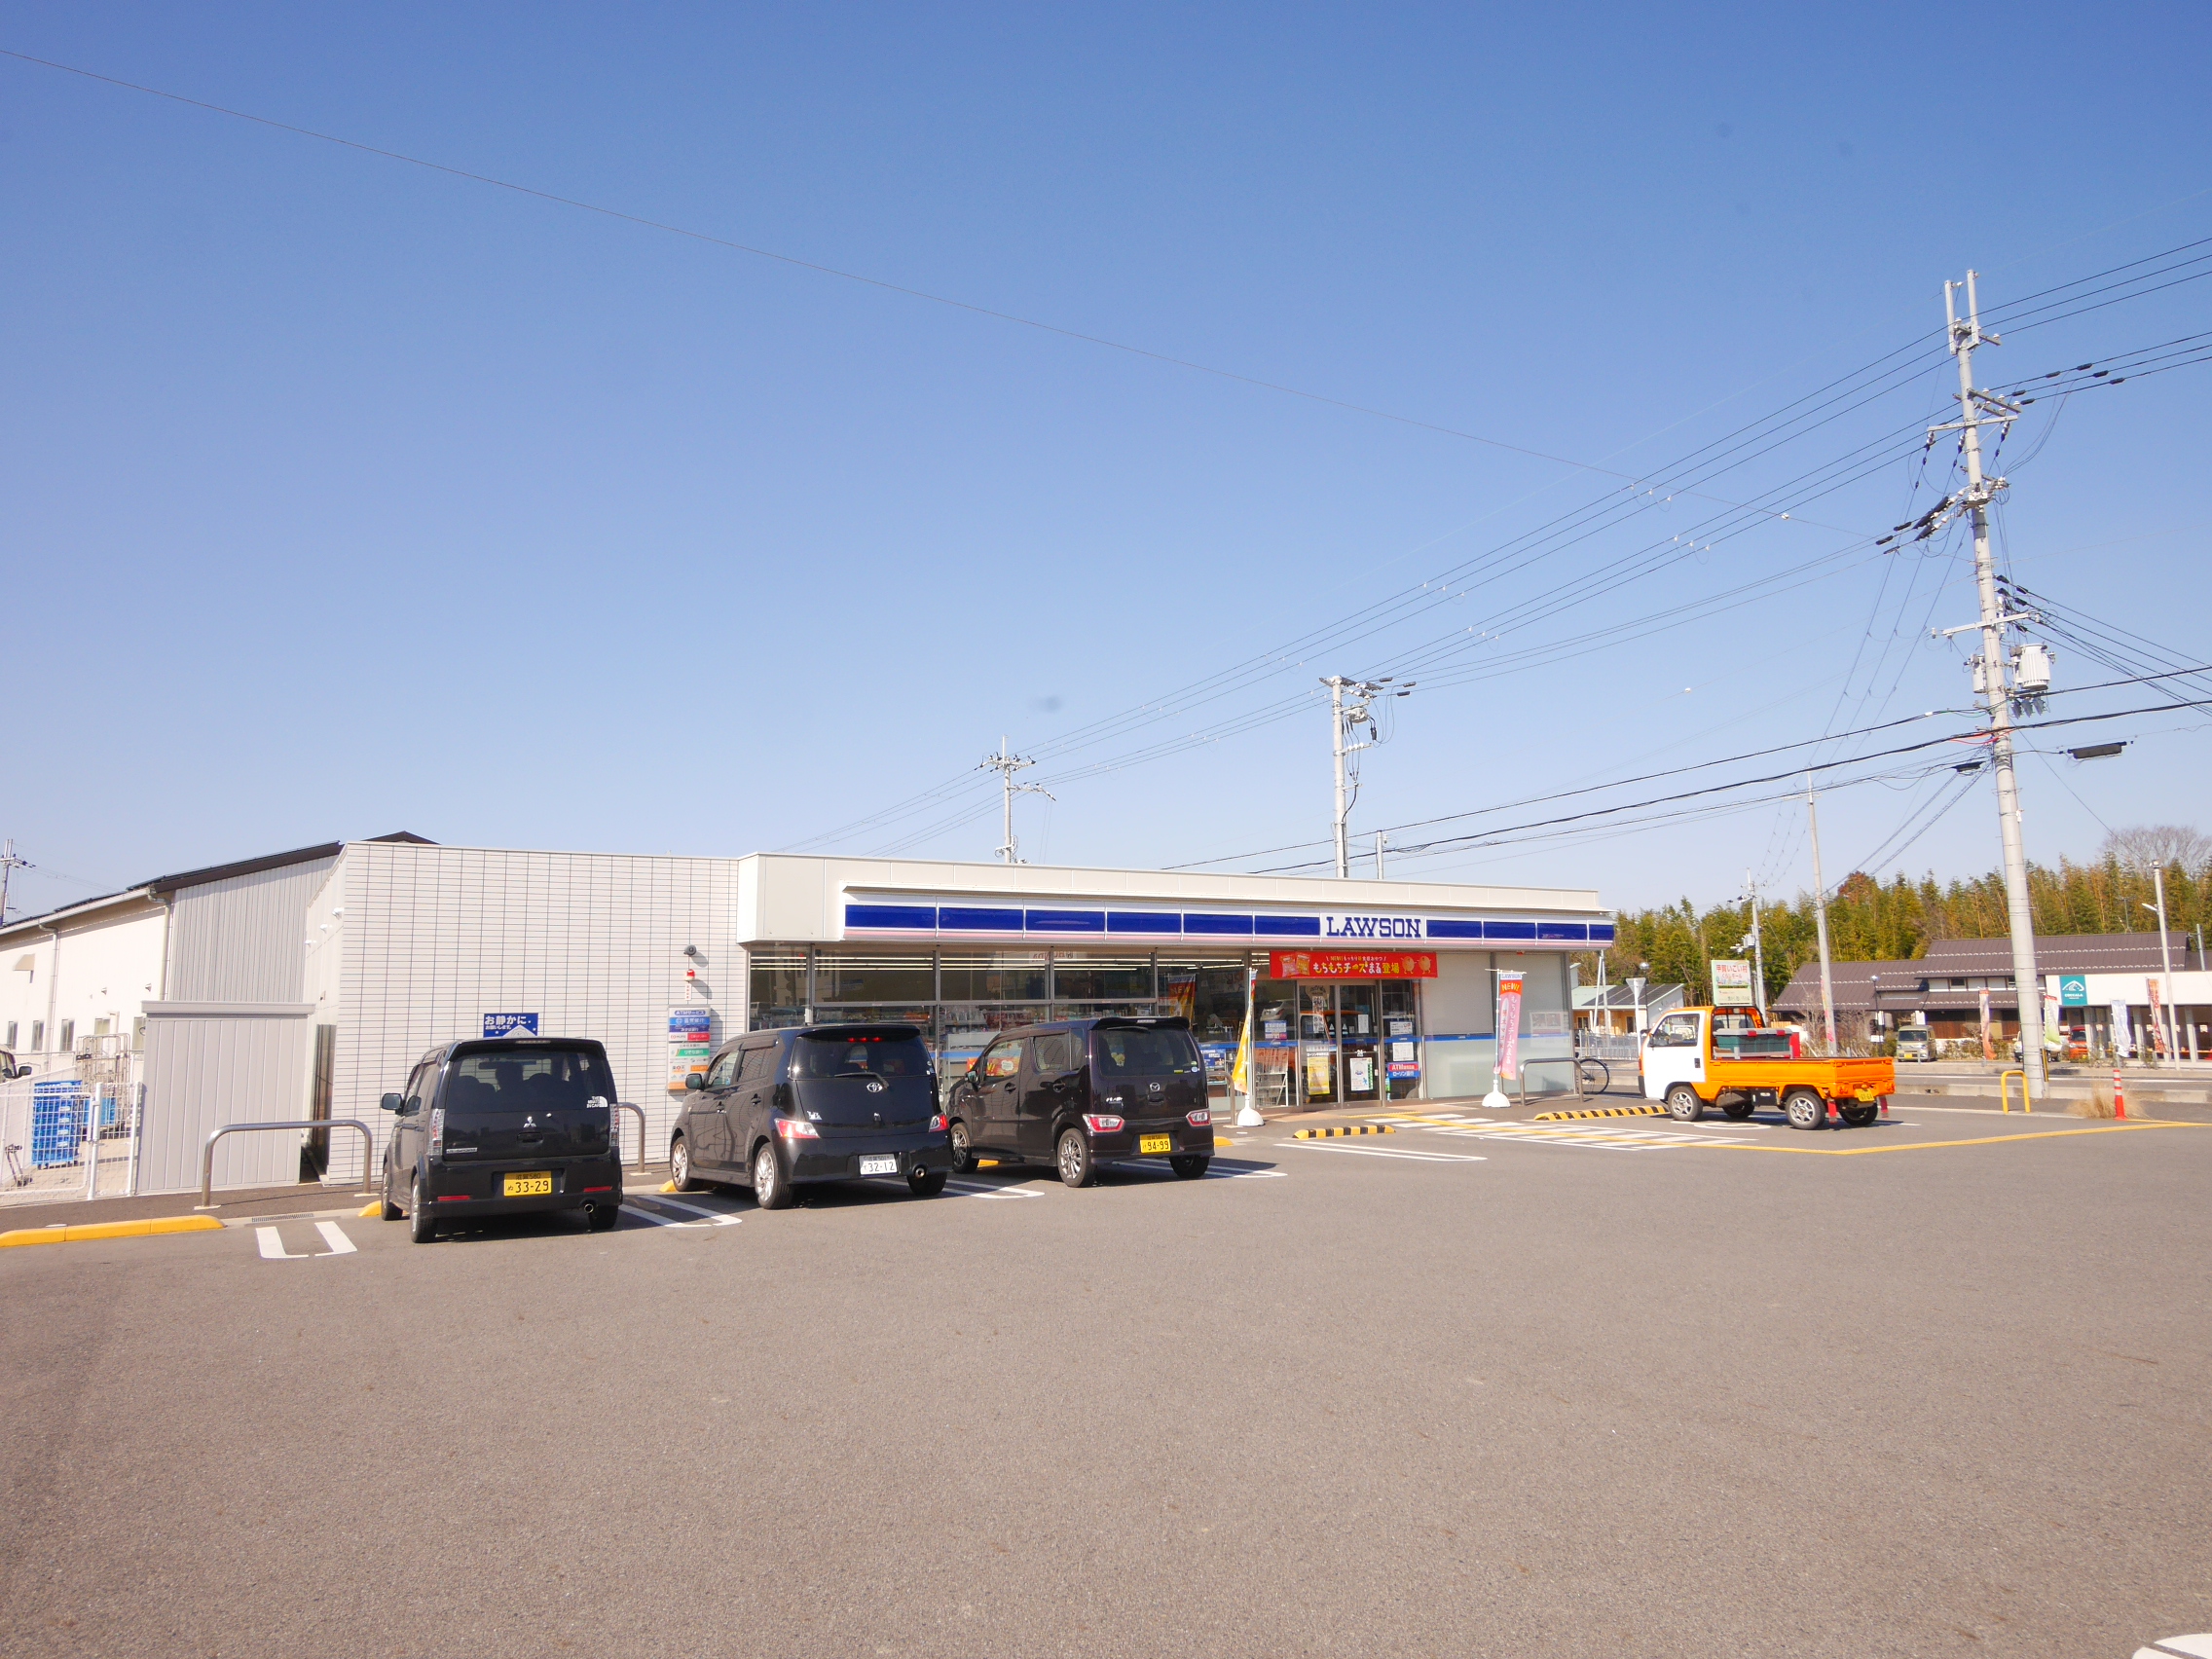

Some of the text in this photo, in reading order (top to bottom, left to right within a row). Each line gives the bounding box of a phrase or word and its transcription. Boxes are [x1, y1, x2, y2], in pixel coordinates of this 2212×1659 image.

[1326, 916, 1420, 938] LAWSON
[1312, 961, 1400, 974] もちもちチーズまる登場
[1501, 983, 1520, 992] NEW!
[485, 1015, 527, 1025] お静かに
[1147, 1140, 1169, 1151] 94-99
[867, 1161, 895, 1172] 32-12
[515, 1180, 549, 1194] 33-29
